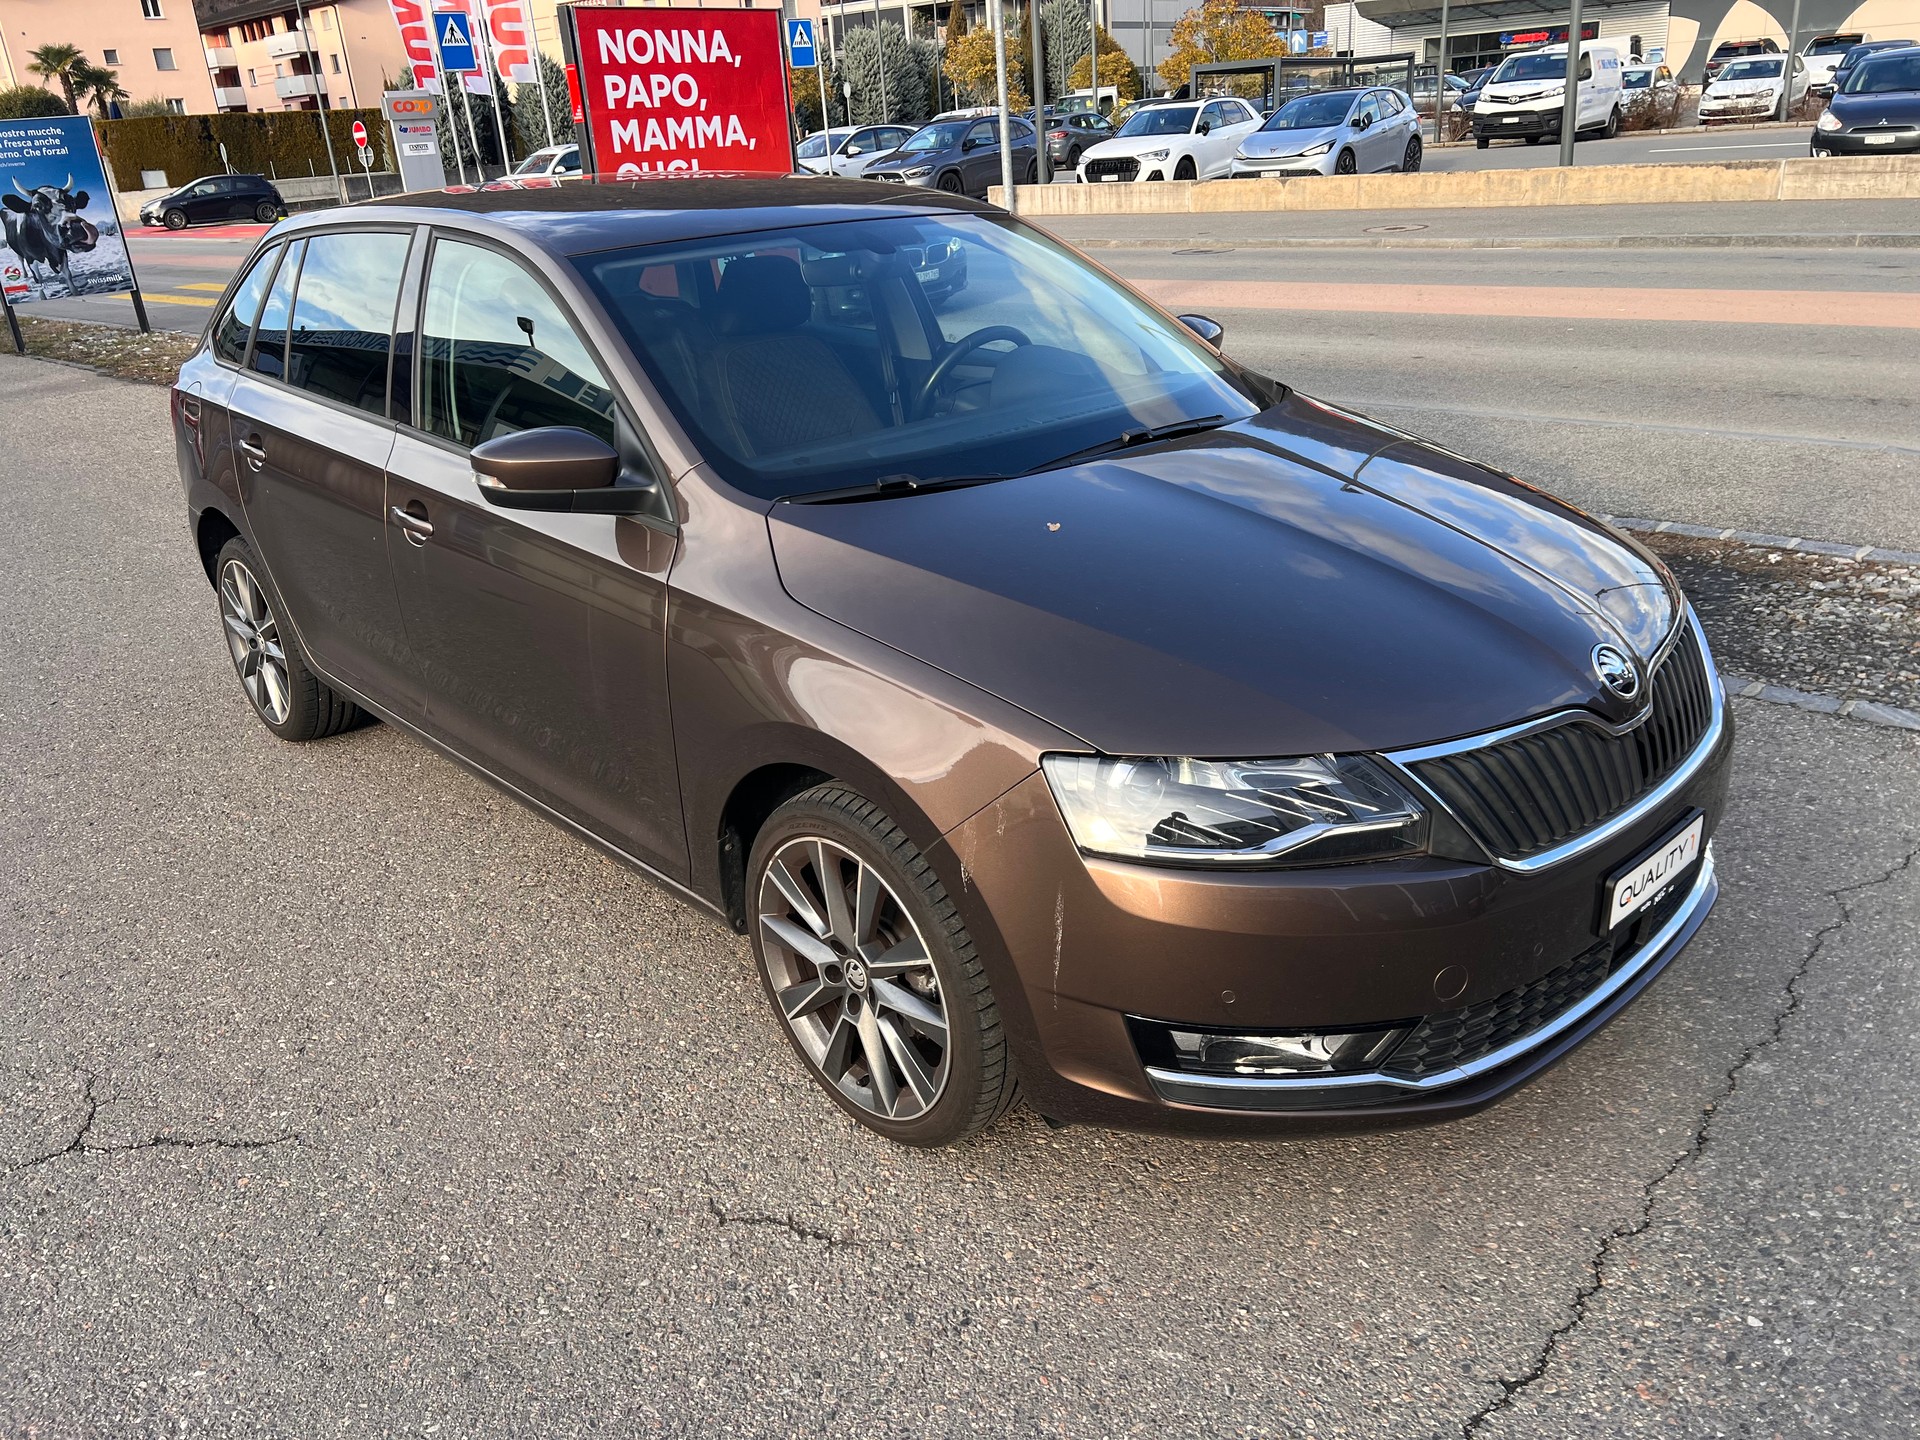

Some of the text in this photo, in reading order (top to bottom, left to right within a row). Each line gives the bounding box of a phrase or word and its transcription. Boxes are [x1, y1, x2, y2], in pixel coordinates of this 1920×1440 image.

[597, 28, 742, 68] NONNA,
[604, 73, 707, 111] PAPO,
[392, 100, 433, 115] coop
[27, 126, 65, 136] mucche,
[610, 115, 756, 153] MAMMA,
[4, 140, 33, 148] fresca
[34, 137, 61, 146] anche
[23, 148, 41, 157] Che
[42, 146, 69, 155] forza!
[87, 274, 124, 284] swissmilk
